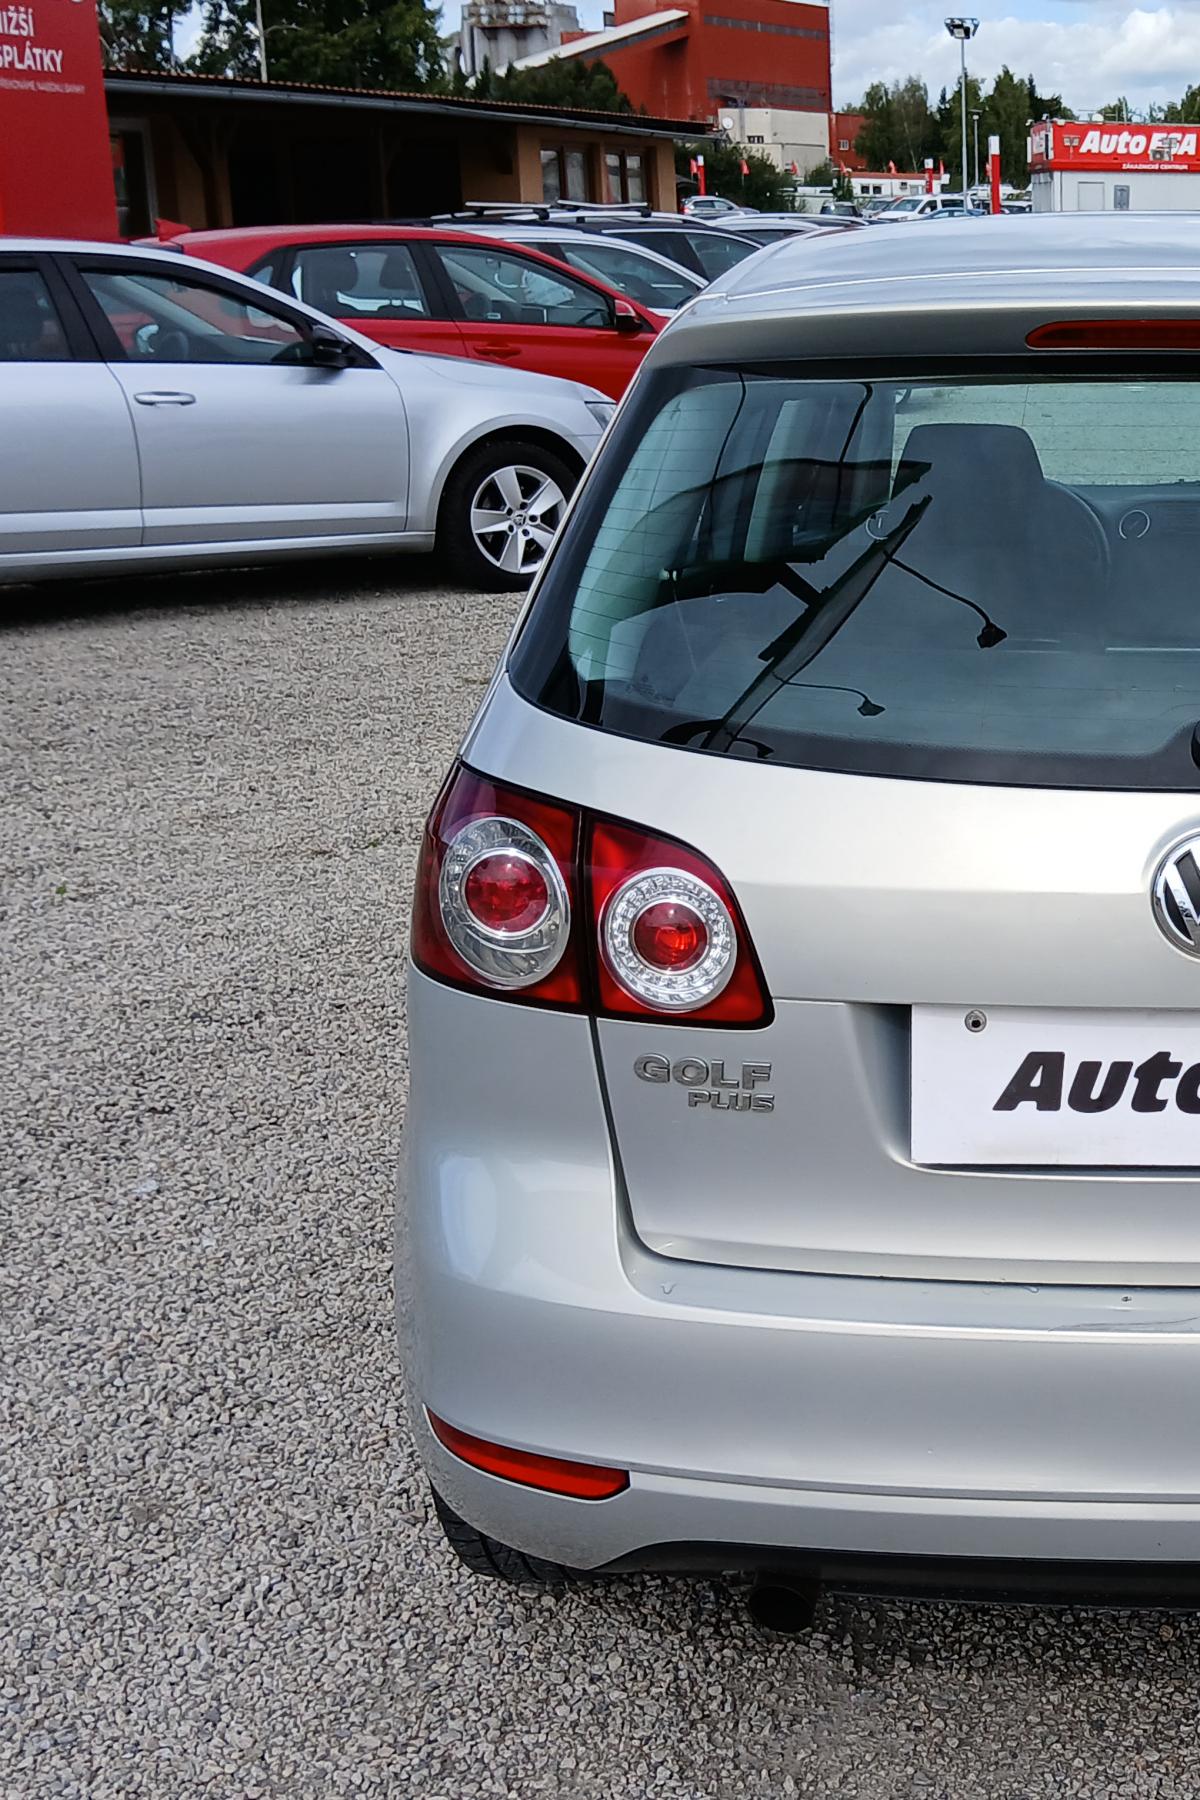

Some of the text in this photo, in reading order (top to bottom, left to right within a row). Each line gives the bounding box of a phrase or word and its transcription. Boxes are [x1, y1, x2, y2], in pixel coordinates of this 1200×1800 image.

[1079, 130, 1147, 155] Auto
[633, 1052, 772, 1091] GOLF
[687, 1088, 775, 1114] PLUS
